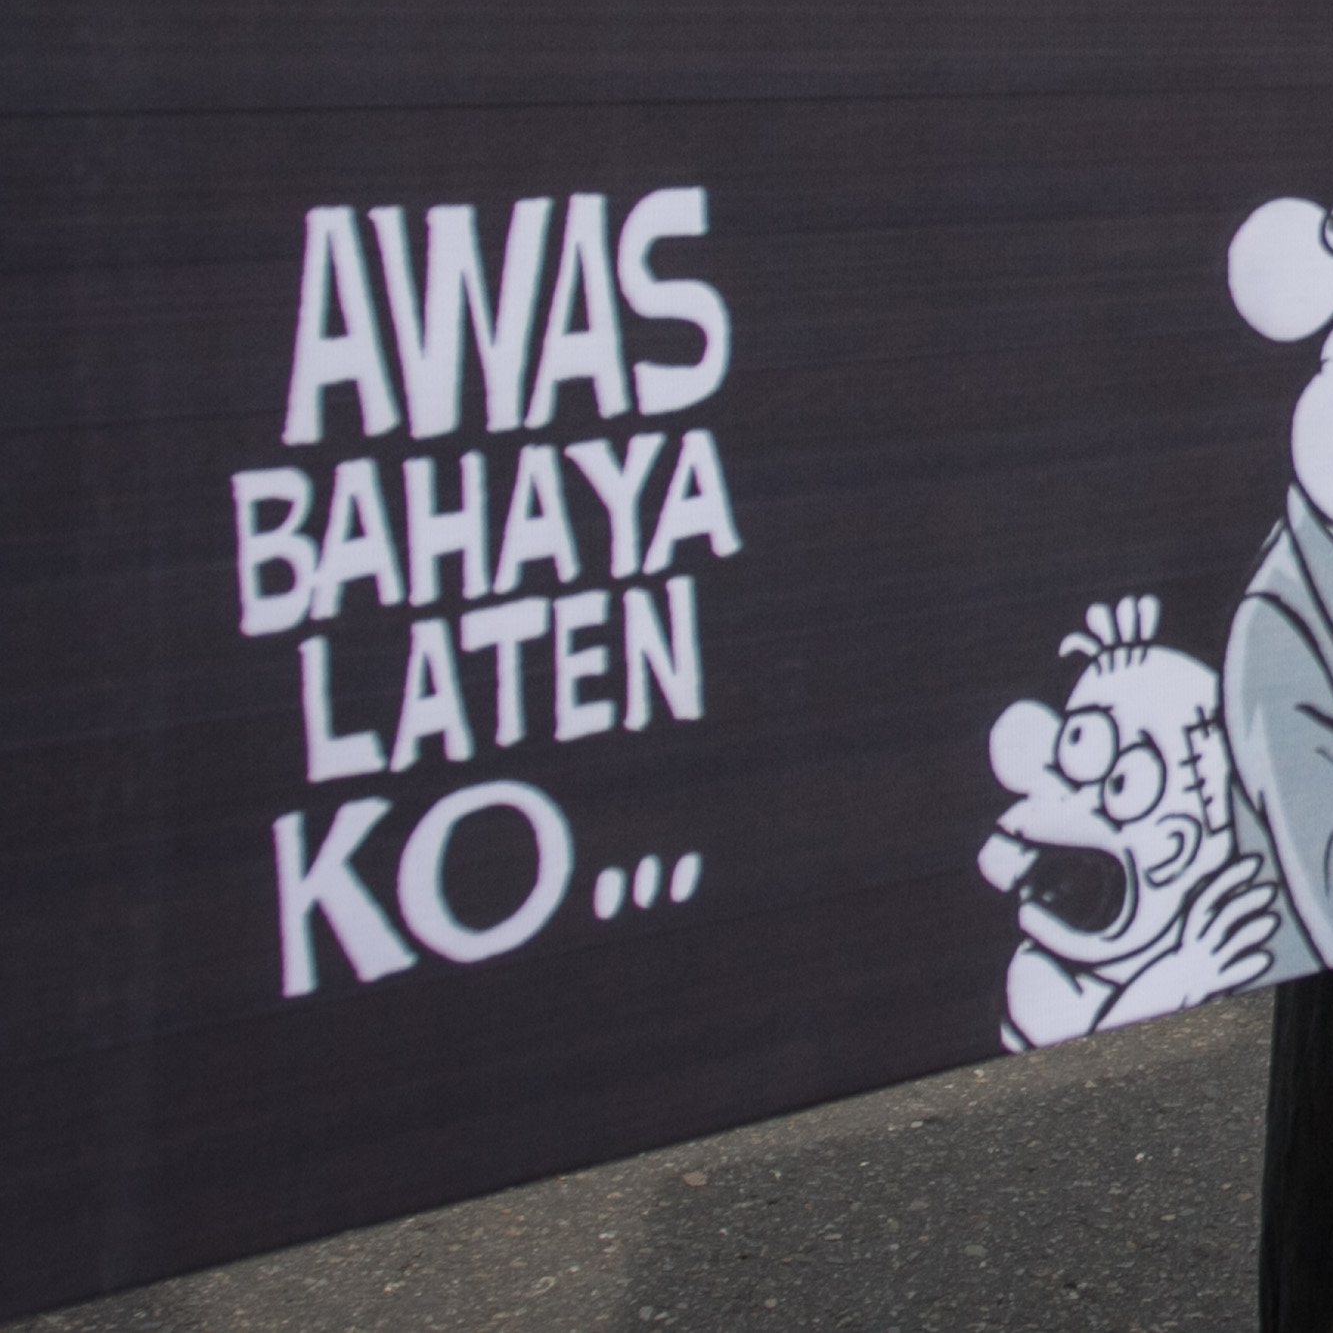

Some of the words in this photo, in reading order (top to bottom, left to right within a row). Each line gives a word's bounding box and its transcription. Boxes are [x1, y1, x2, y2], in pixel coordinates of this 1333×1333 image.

[282, 186, 730, 446] AWAS
[232, 429, 741, 636] BAHAYA
[299, 575, 702, 782] LATEN
